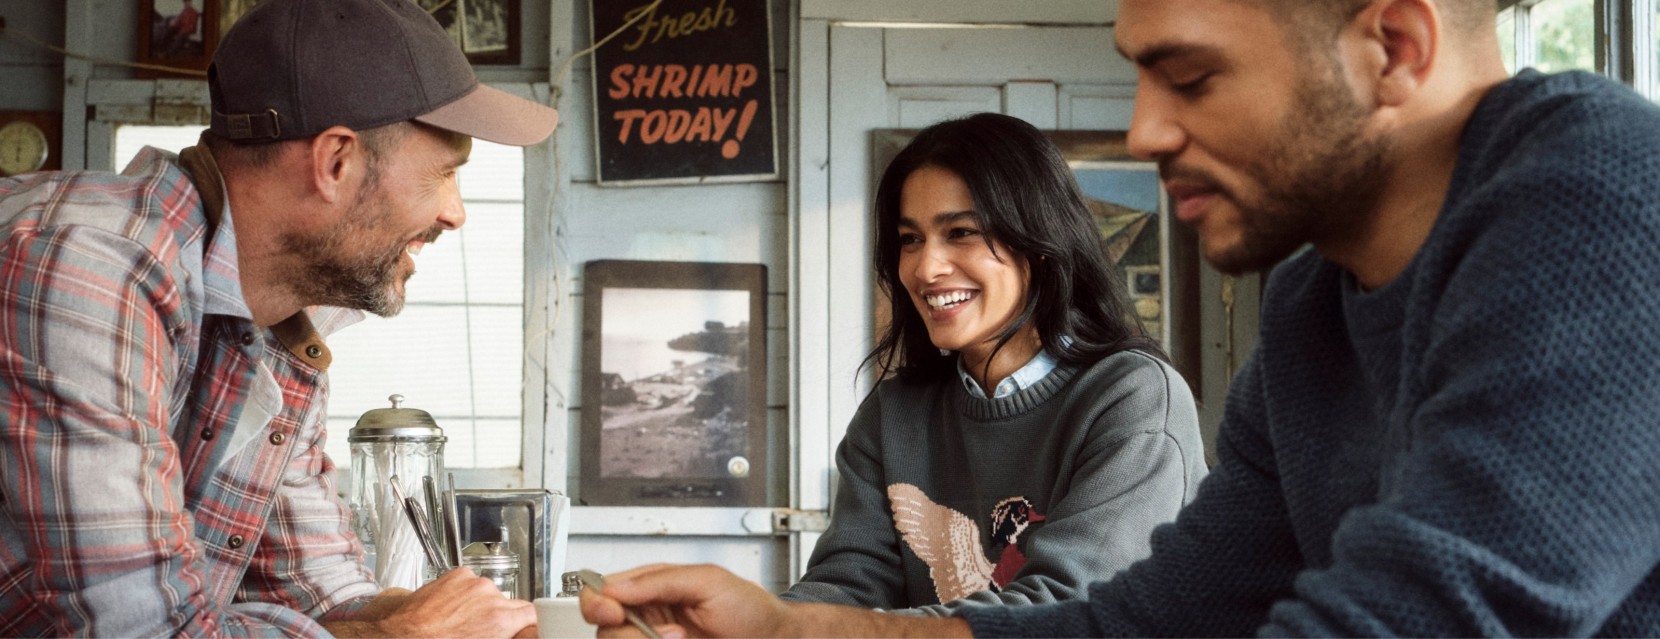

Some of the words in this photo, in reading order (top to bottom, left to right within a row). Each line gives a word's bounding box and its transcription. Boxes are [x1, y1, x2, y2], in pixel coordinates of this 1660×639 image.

[623, 0, 736, 50] Fresh
[608, 63, 758, 99] SHRIMP
[613, 99, 758, 160] TODAY!
